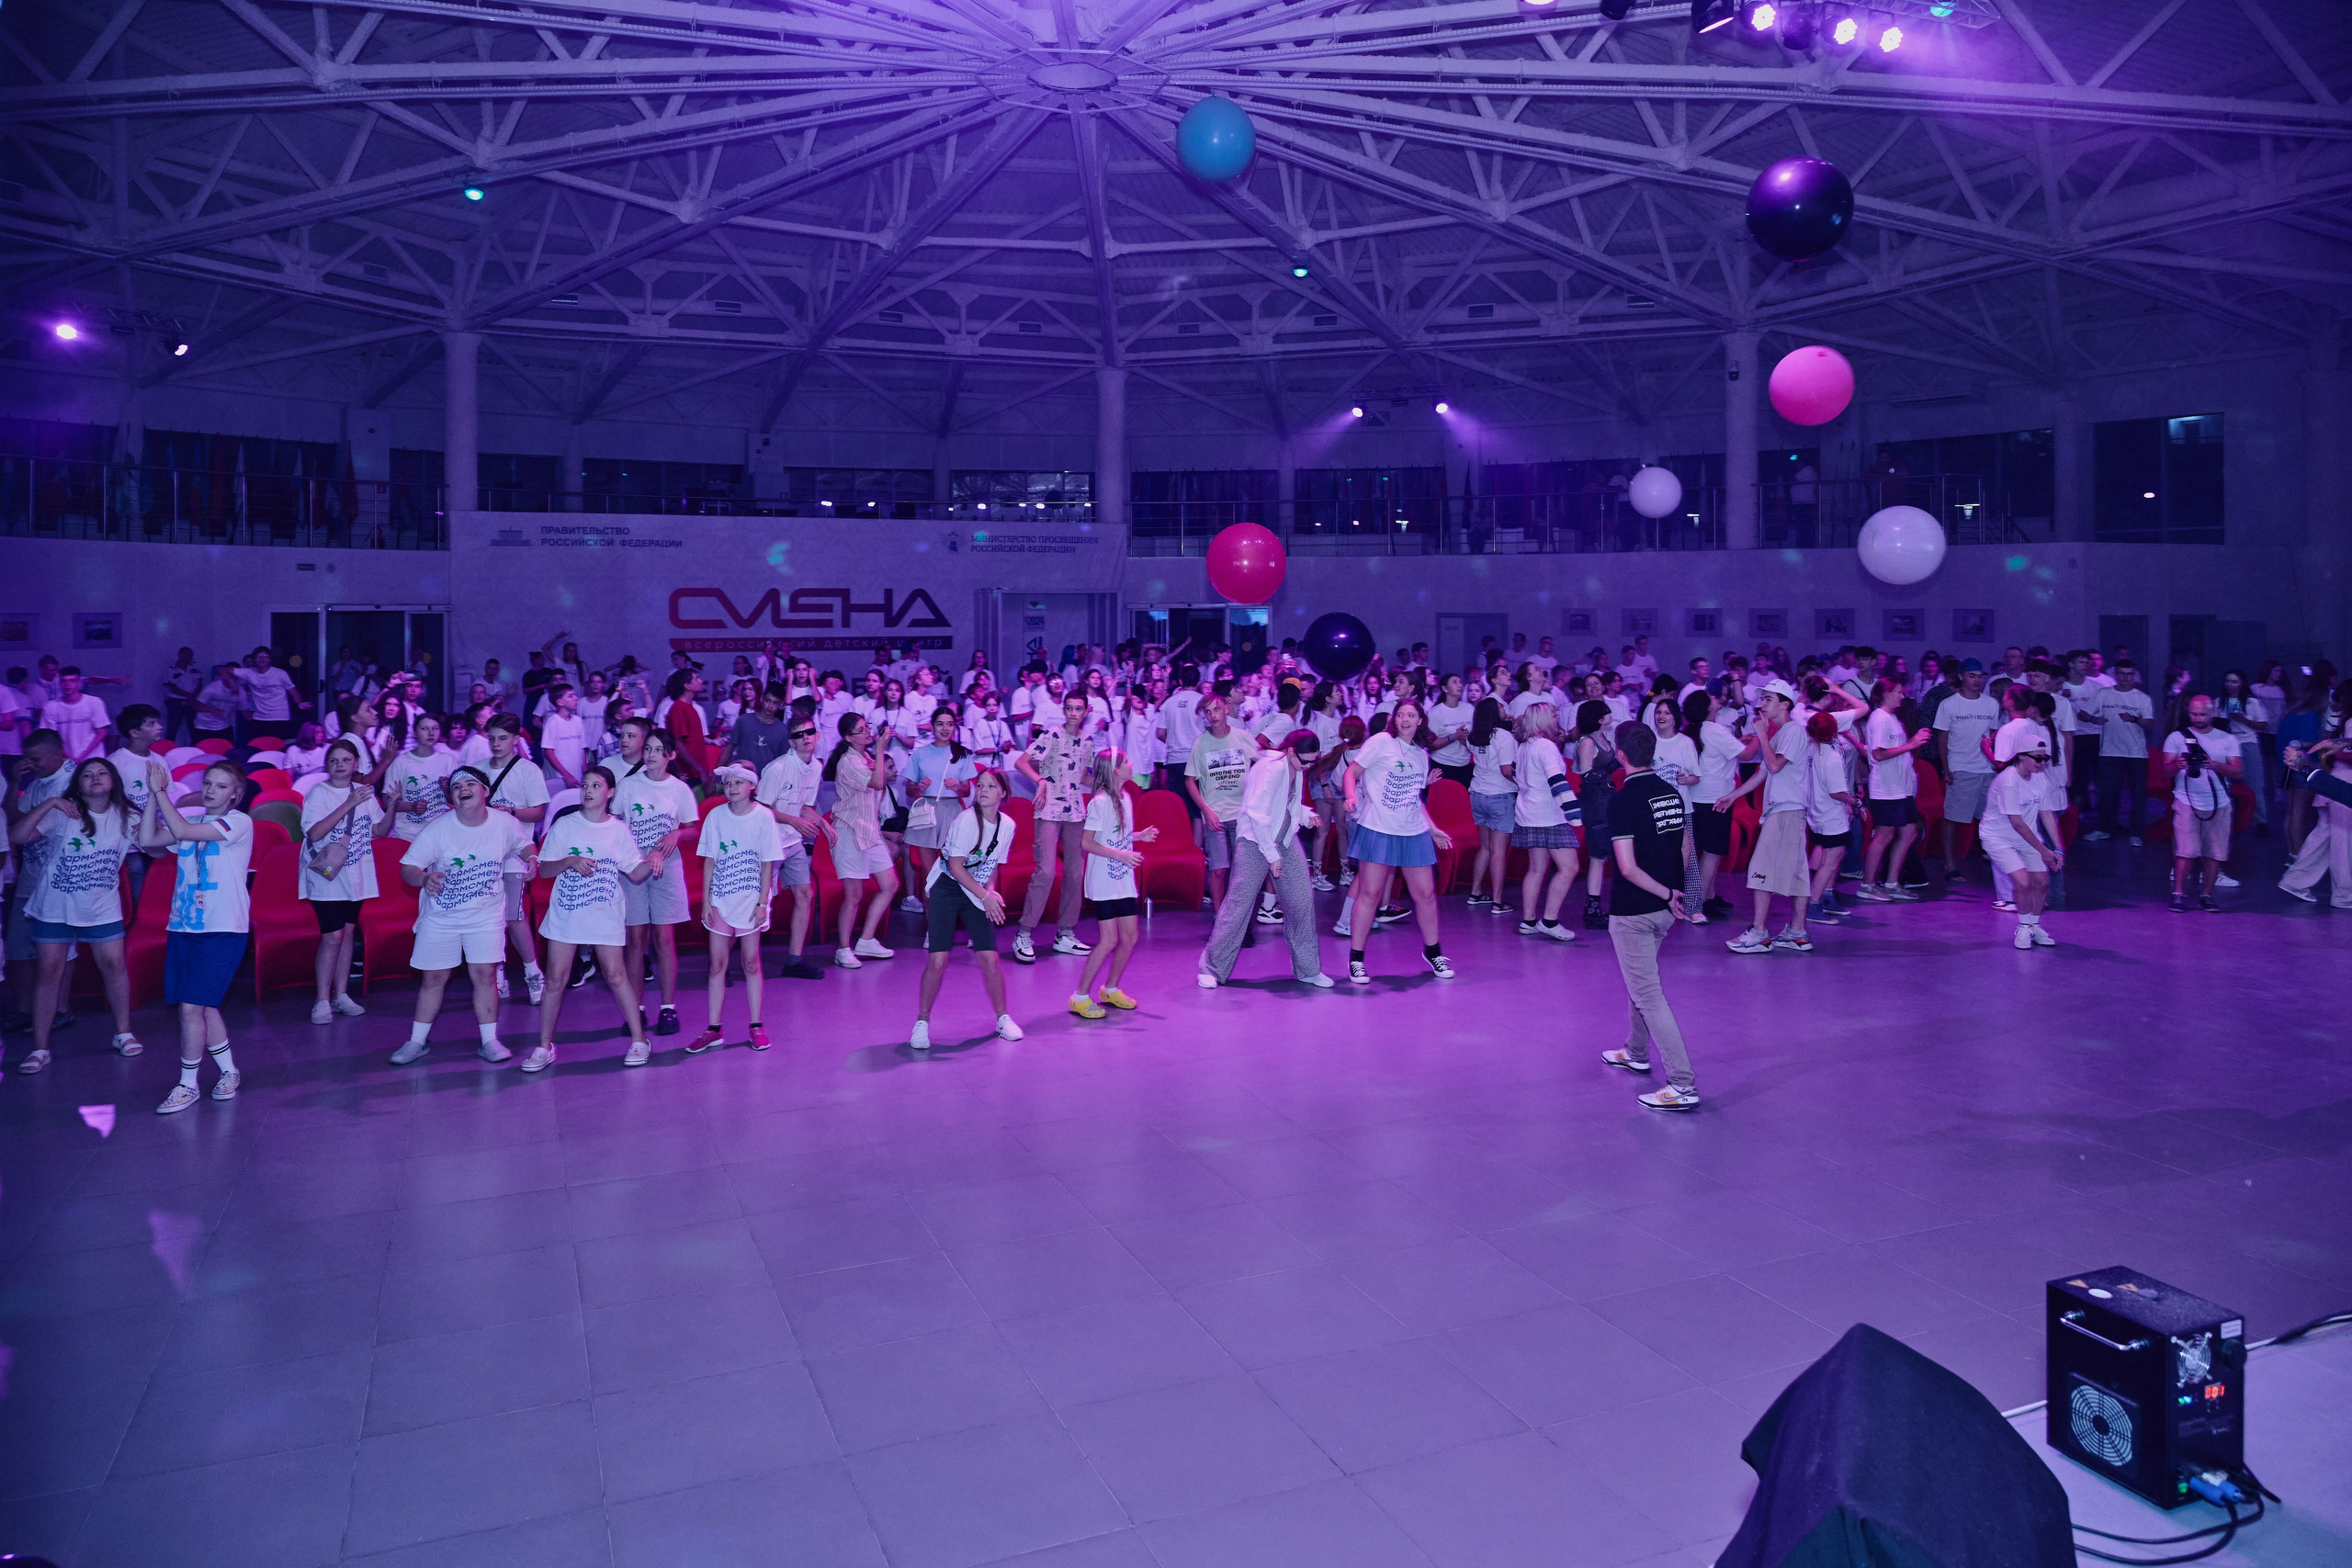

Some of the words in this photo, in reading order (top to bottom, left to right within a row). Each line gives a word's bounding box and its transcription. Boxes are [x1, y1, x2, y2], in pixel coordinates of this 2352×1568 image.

[541, 526, 629, 536] ПРАВИТЕЛЬСТВО
[541, 537, 614, 547] РОССИЙСКОЙ
[619, 538, 683, 548] ФЕДЕРАЦИИ
[970, 535, 1036, 543] МИНИСТЕРСТВО
[1039, 536, 1098, 545] ПРОСВЕЩЕНИЯ
[970, 544, 1025, 553] РОССИЙСКОЙ
[1027, 545, 1076, 554] ФЕДЕРАЦИИ
[668, 587, 952, 629] СМЕНА
[897, 637, 943, 650] цтр
